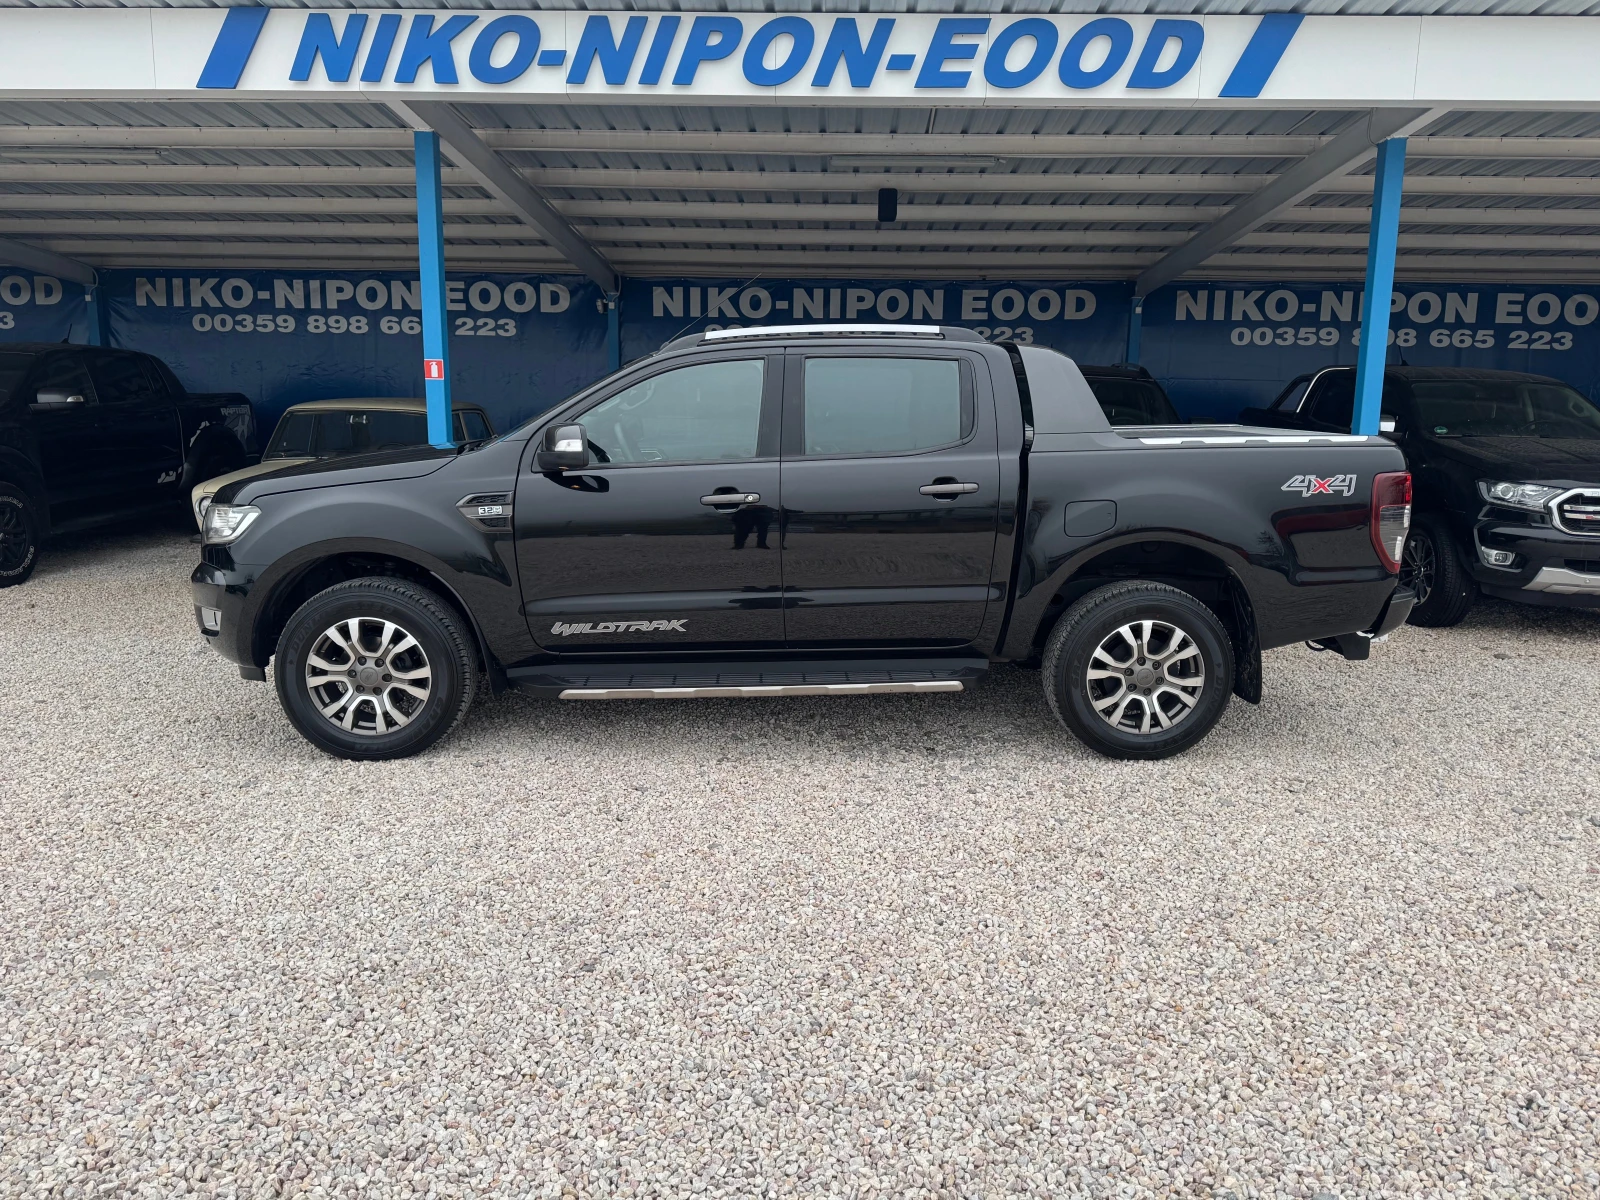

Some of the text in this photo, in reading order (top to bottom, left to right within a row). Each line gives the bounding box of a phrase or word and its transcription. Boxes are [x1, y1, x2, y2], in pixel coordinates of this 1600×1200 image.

[289, 13, 1204, 89] NIKO-NIPON-EOOD
[135, 277, 571, 313] NIKO-NIPON EOOD
[652, 286, 1097, 321] NIKO-NIPON EOOD
[192, 313, 517, 337] 00359 898 66 223
[1230, 327, 1340, 346] 00359
[1429, 329, 1495, 348] 665
[1507, 330, 1574, 350] 223
[551, 619, 689, 637] WILDTRAK
